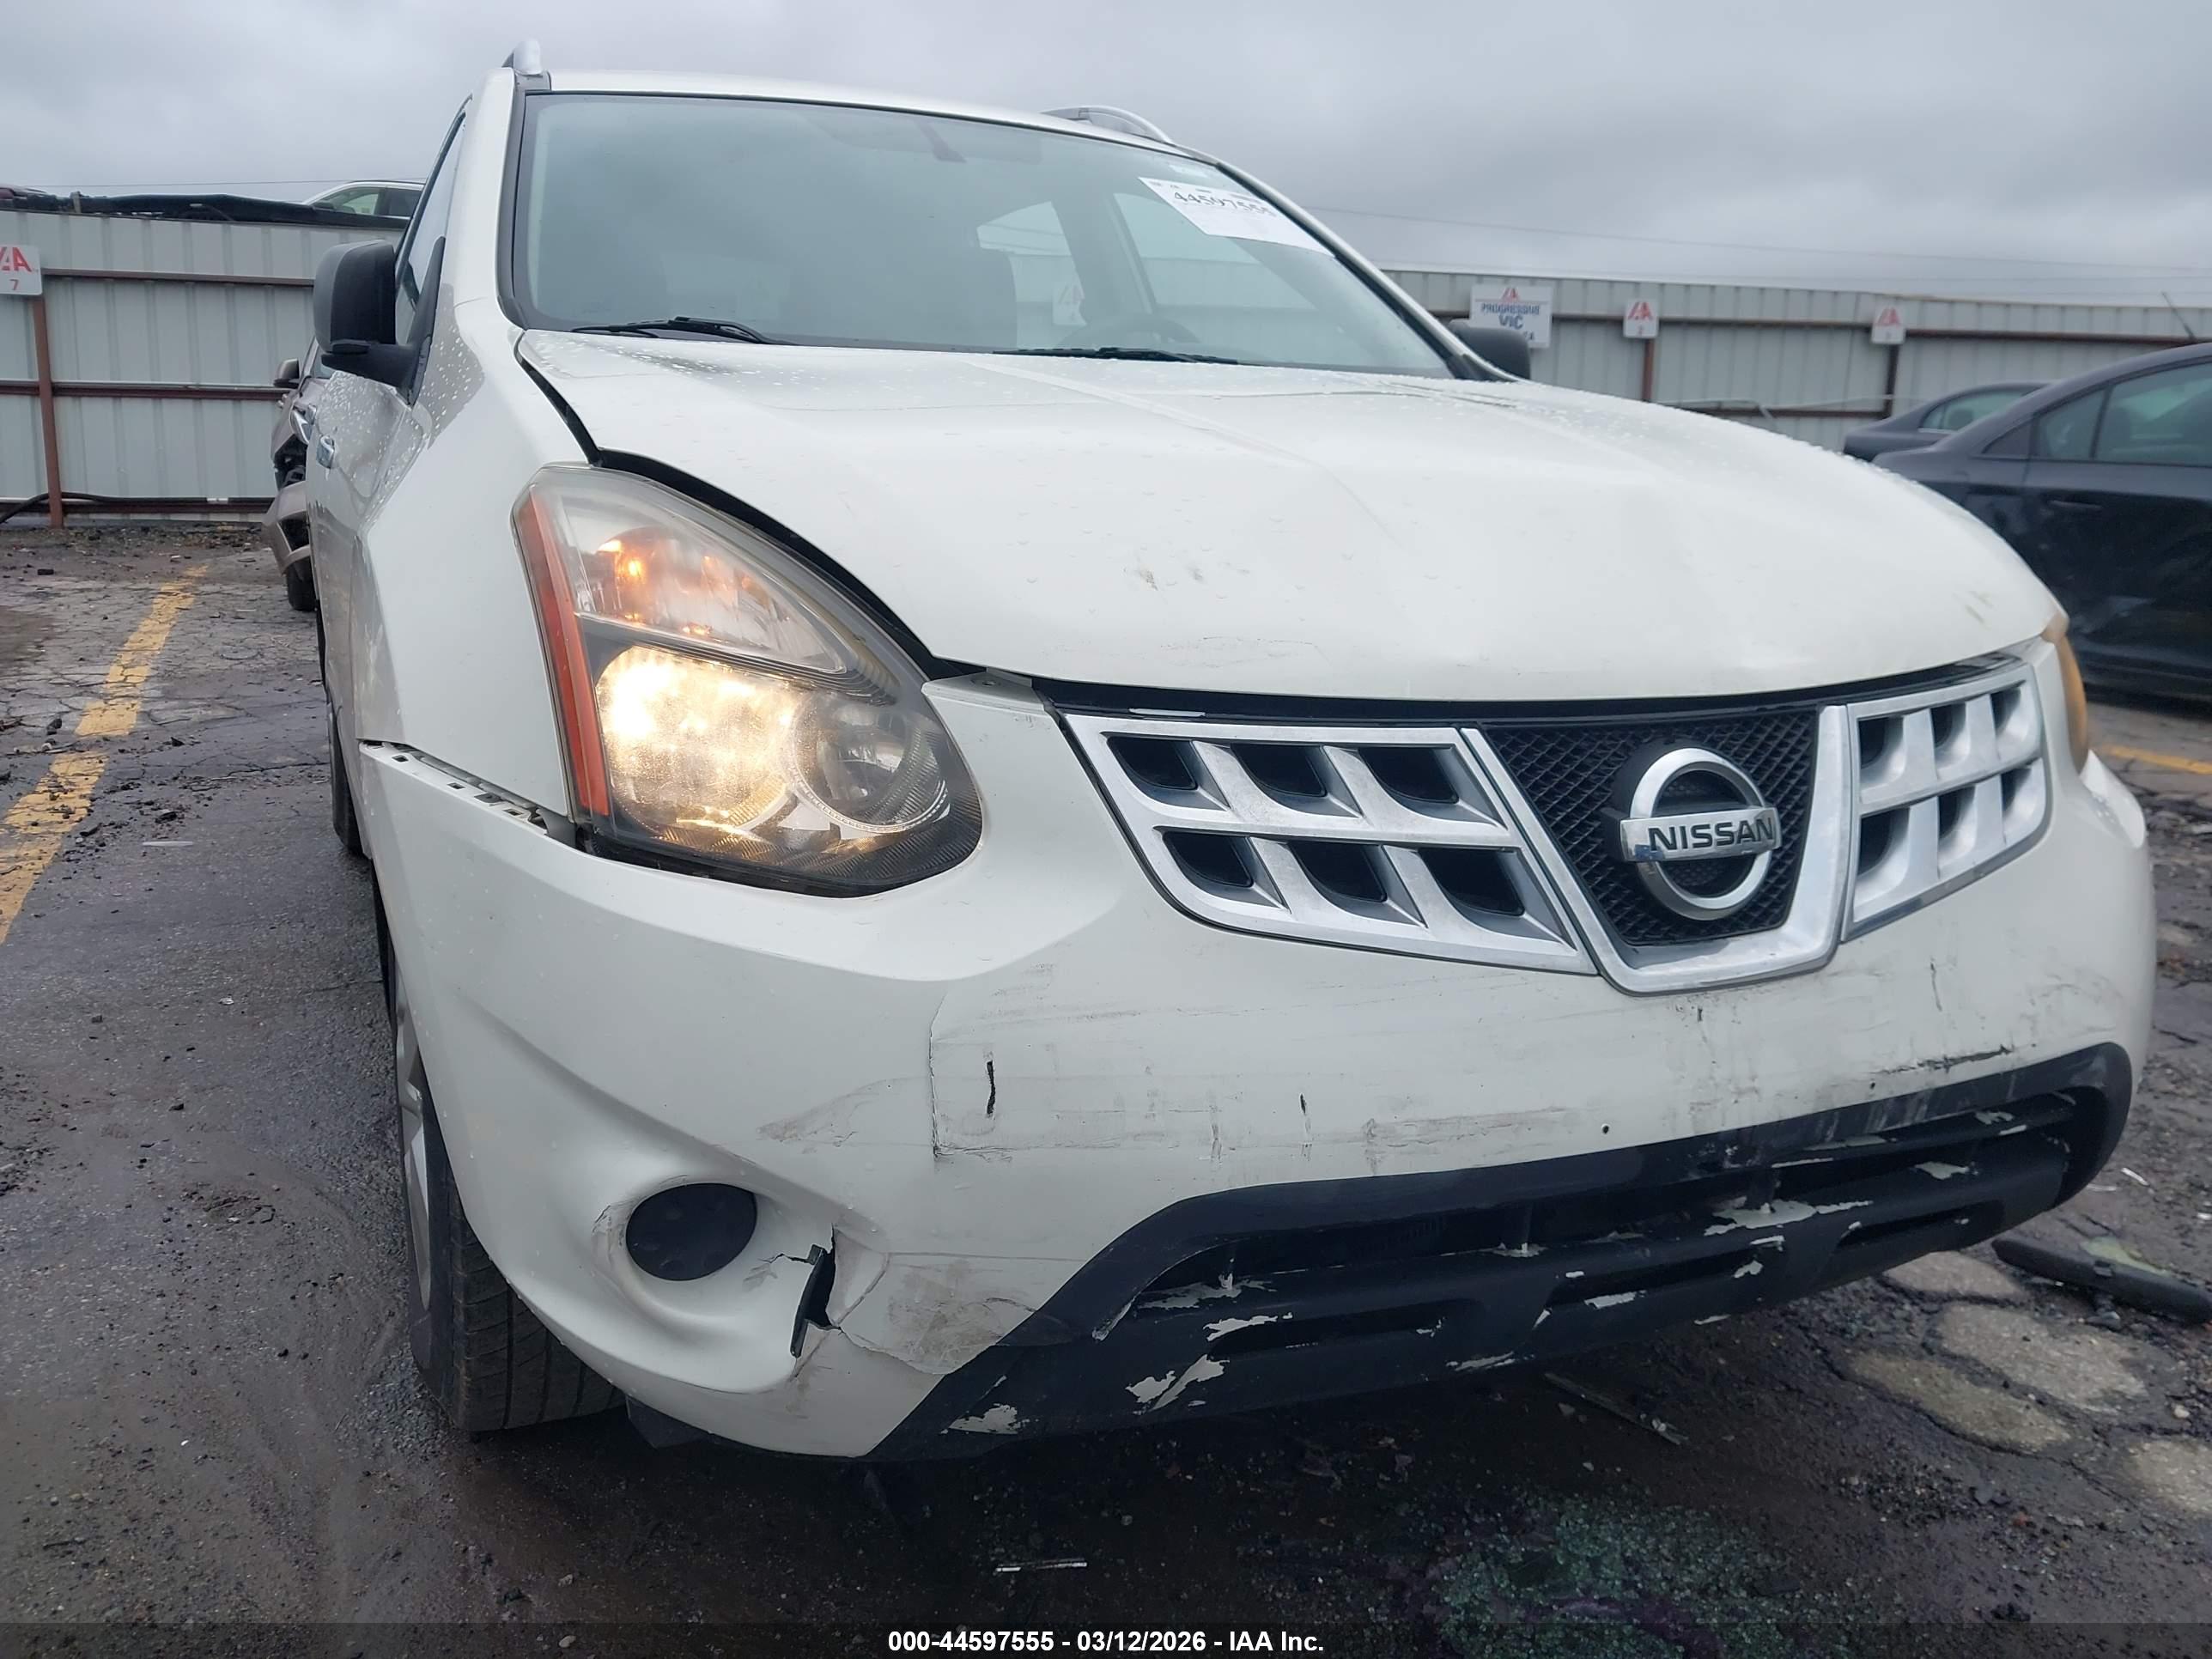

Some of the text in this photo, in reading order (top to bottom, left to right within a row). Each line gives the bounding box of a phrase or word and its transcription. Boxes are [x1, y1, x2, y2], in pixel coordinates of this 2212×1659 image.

[9, 279, 19, 291] 7
[1498, 314, 1523, 330] VIC
[1648, 817, 1773, 851] NISSAN
